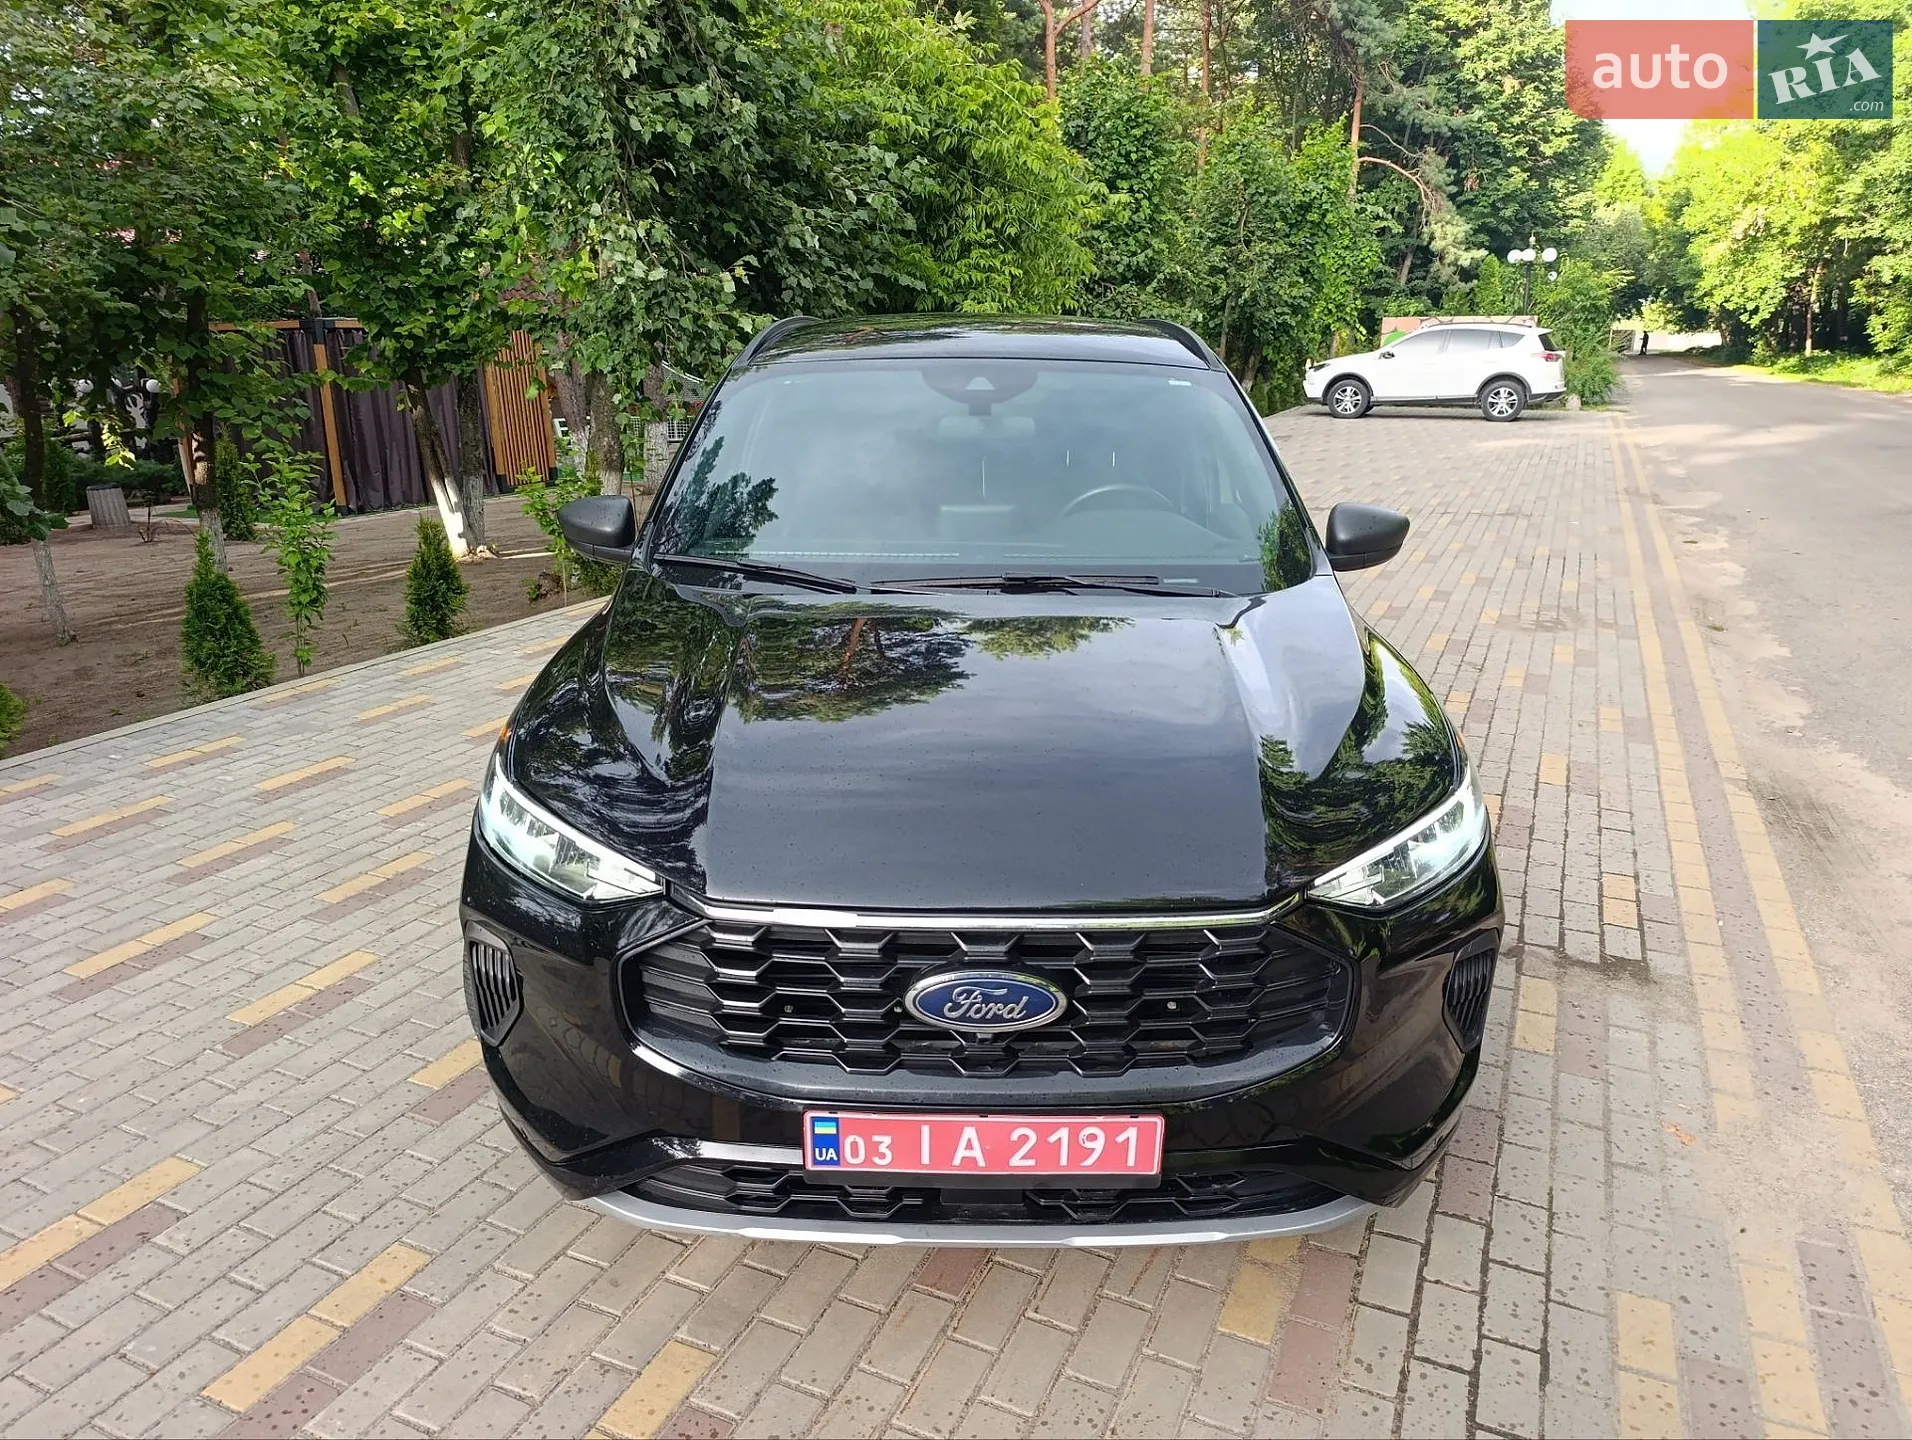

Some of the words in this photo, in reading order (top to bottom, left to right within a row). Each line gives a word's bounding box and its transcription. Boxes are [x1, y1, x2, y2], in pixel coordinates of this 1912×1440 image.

[943, 985, 1029, 1020] Ford
[815, 1147, 838, 1161] UA
[843, 1135, 893, 1166] 03
[919, 1124, 986, 1168] IA
[1008, 1126, 1138, 1167] 2191
